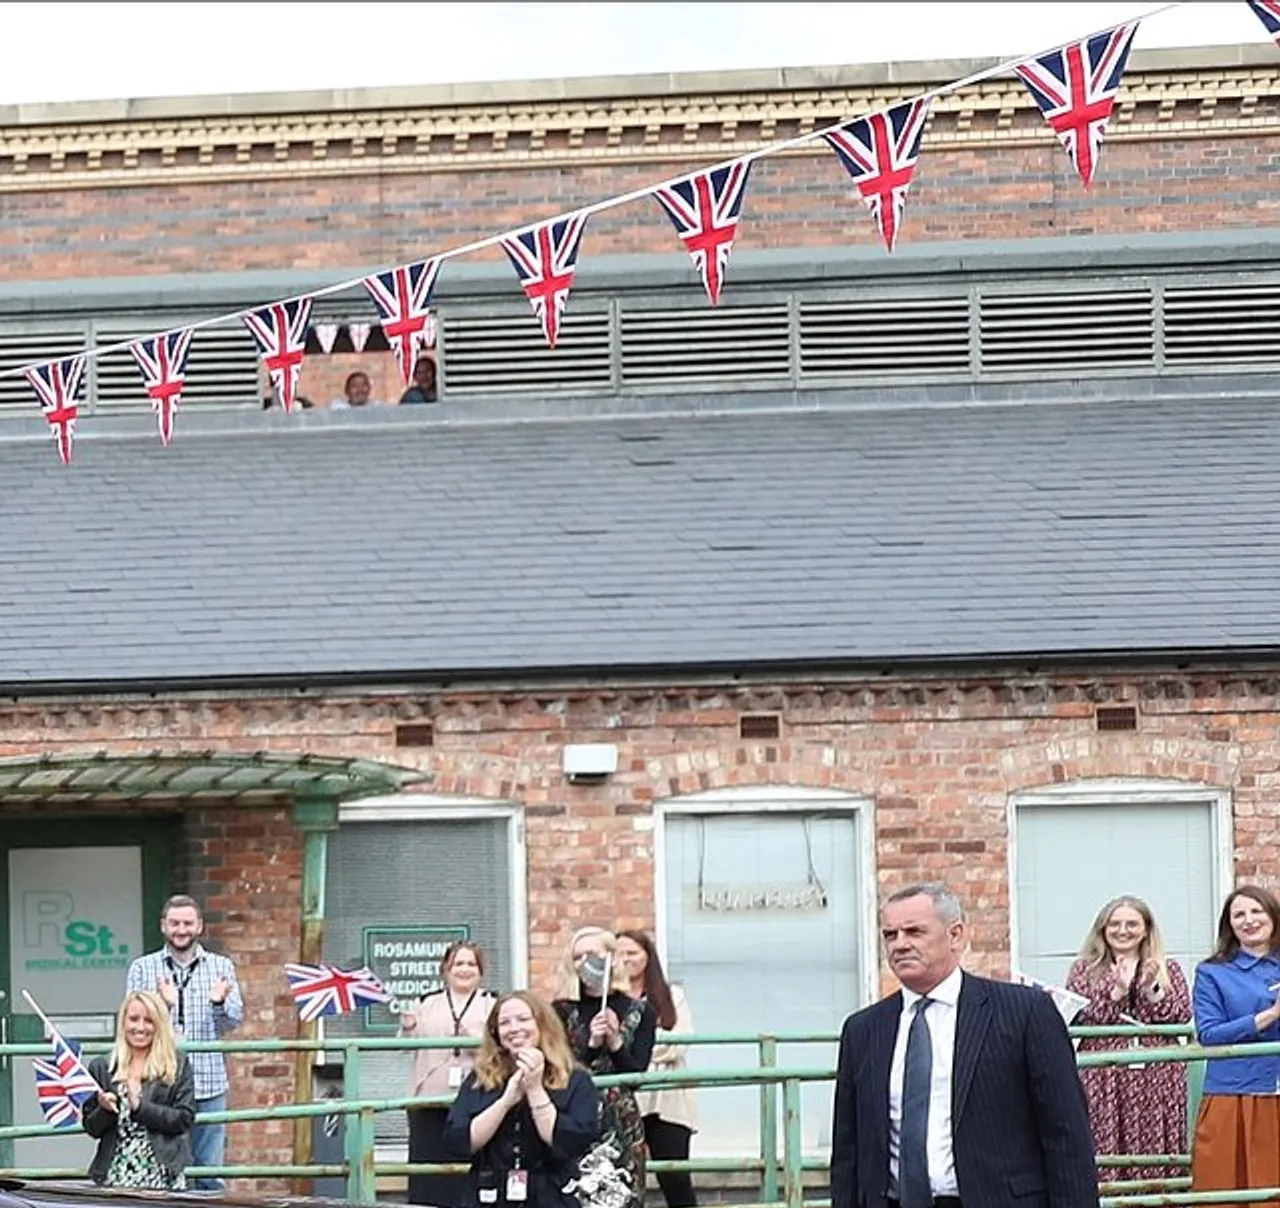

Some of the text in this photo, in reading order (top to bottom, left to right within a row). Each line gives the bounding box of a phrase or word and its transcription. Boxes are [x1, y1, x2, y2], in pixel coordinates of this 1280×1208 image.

[373, 942, 453, 958] ROSAMUN
[25, 959, 78, 972] MEDICAL
[390, 961, 442, 977] STREET
